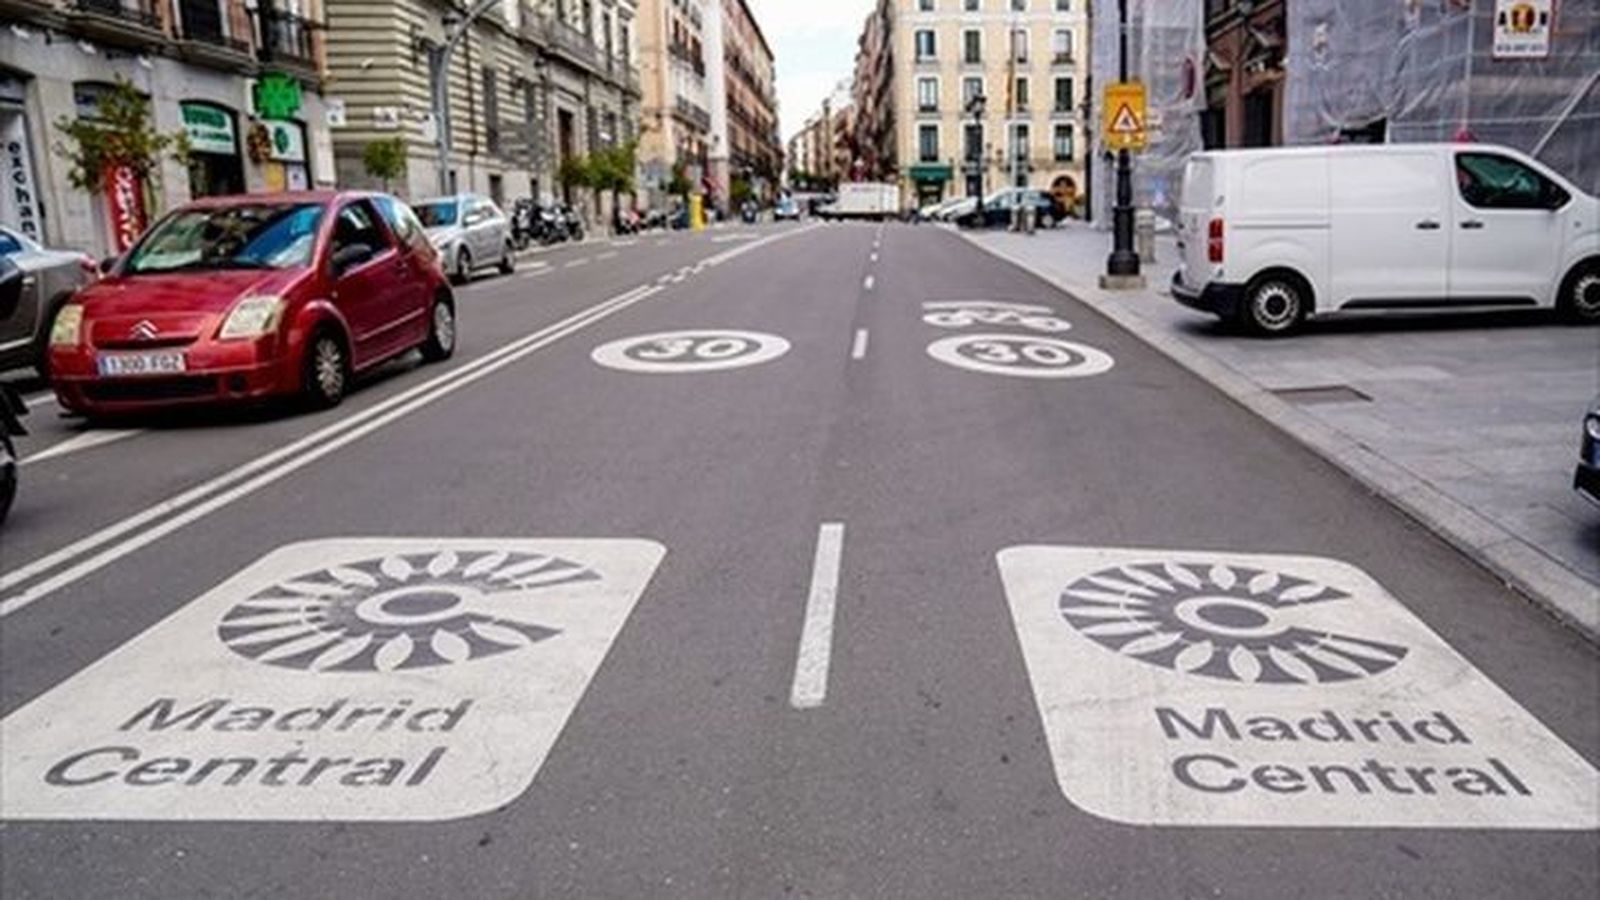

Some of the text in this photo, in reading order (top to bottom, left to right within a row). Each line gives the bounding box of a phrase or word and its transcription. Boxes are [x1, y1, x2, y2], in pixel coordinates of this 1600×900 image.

[637, 338, 748, 359] 30
[971, 341, 1070, 365] 30
[117, 698, 474, 732] Madrid
[1155, 707, 1473, 745] Madrid
[44, 745, 447, 787] Central
[1171, 753, 1532, 797] Central
